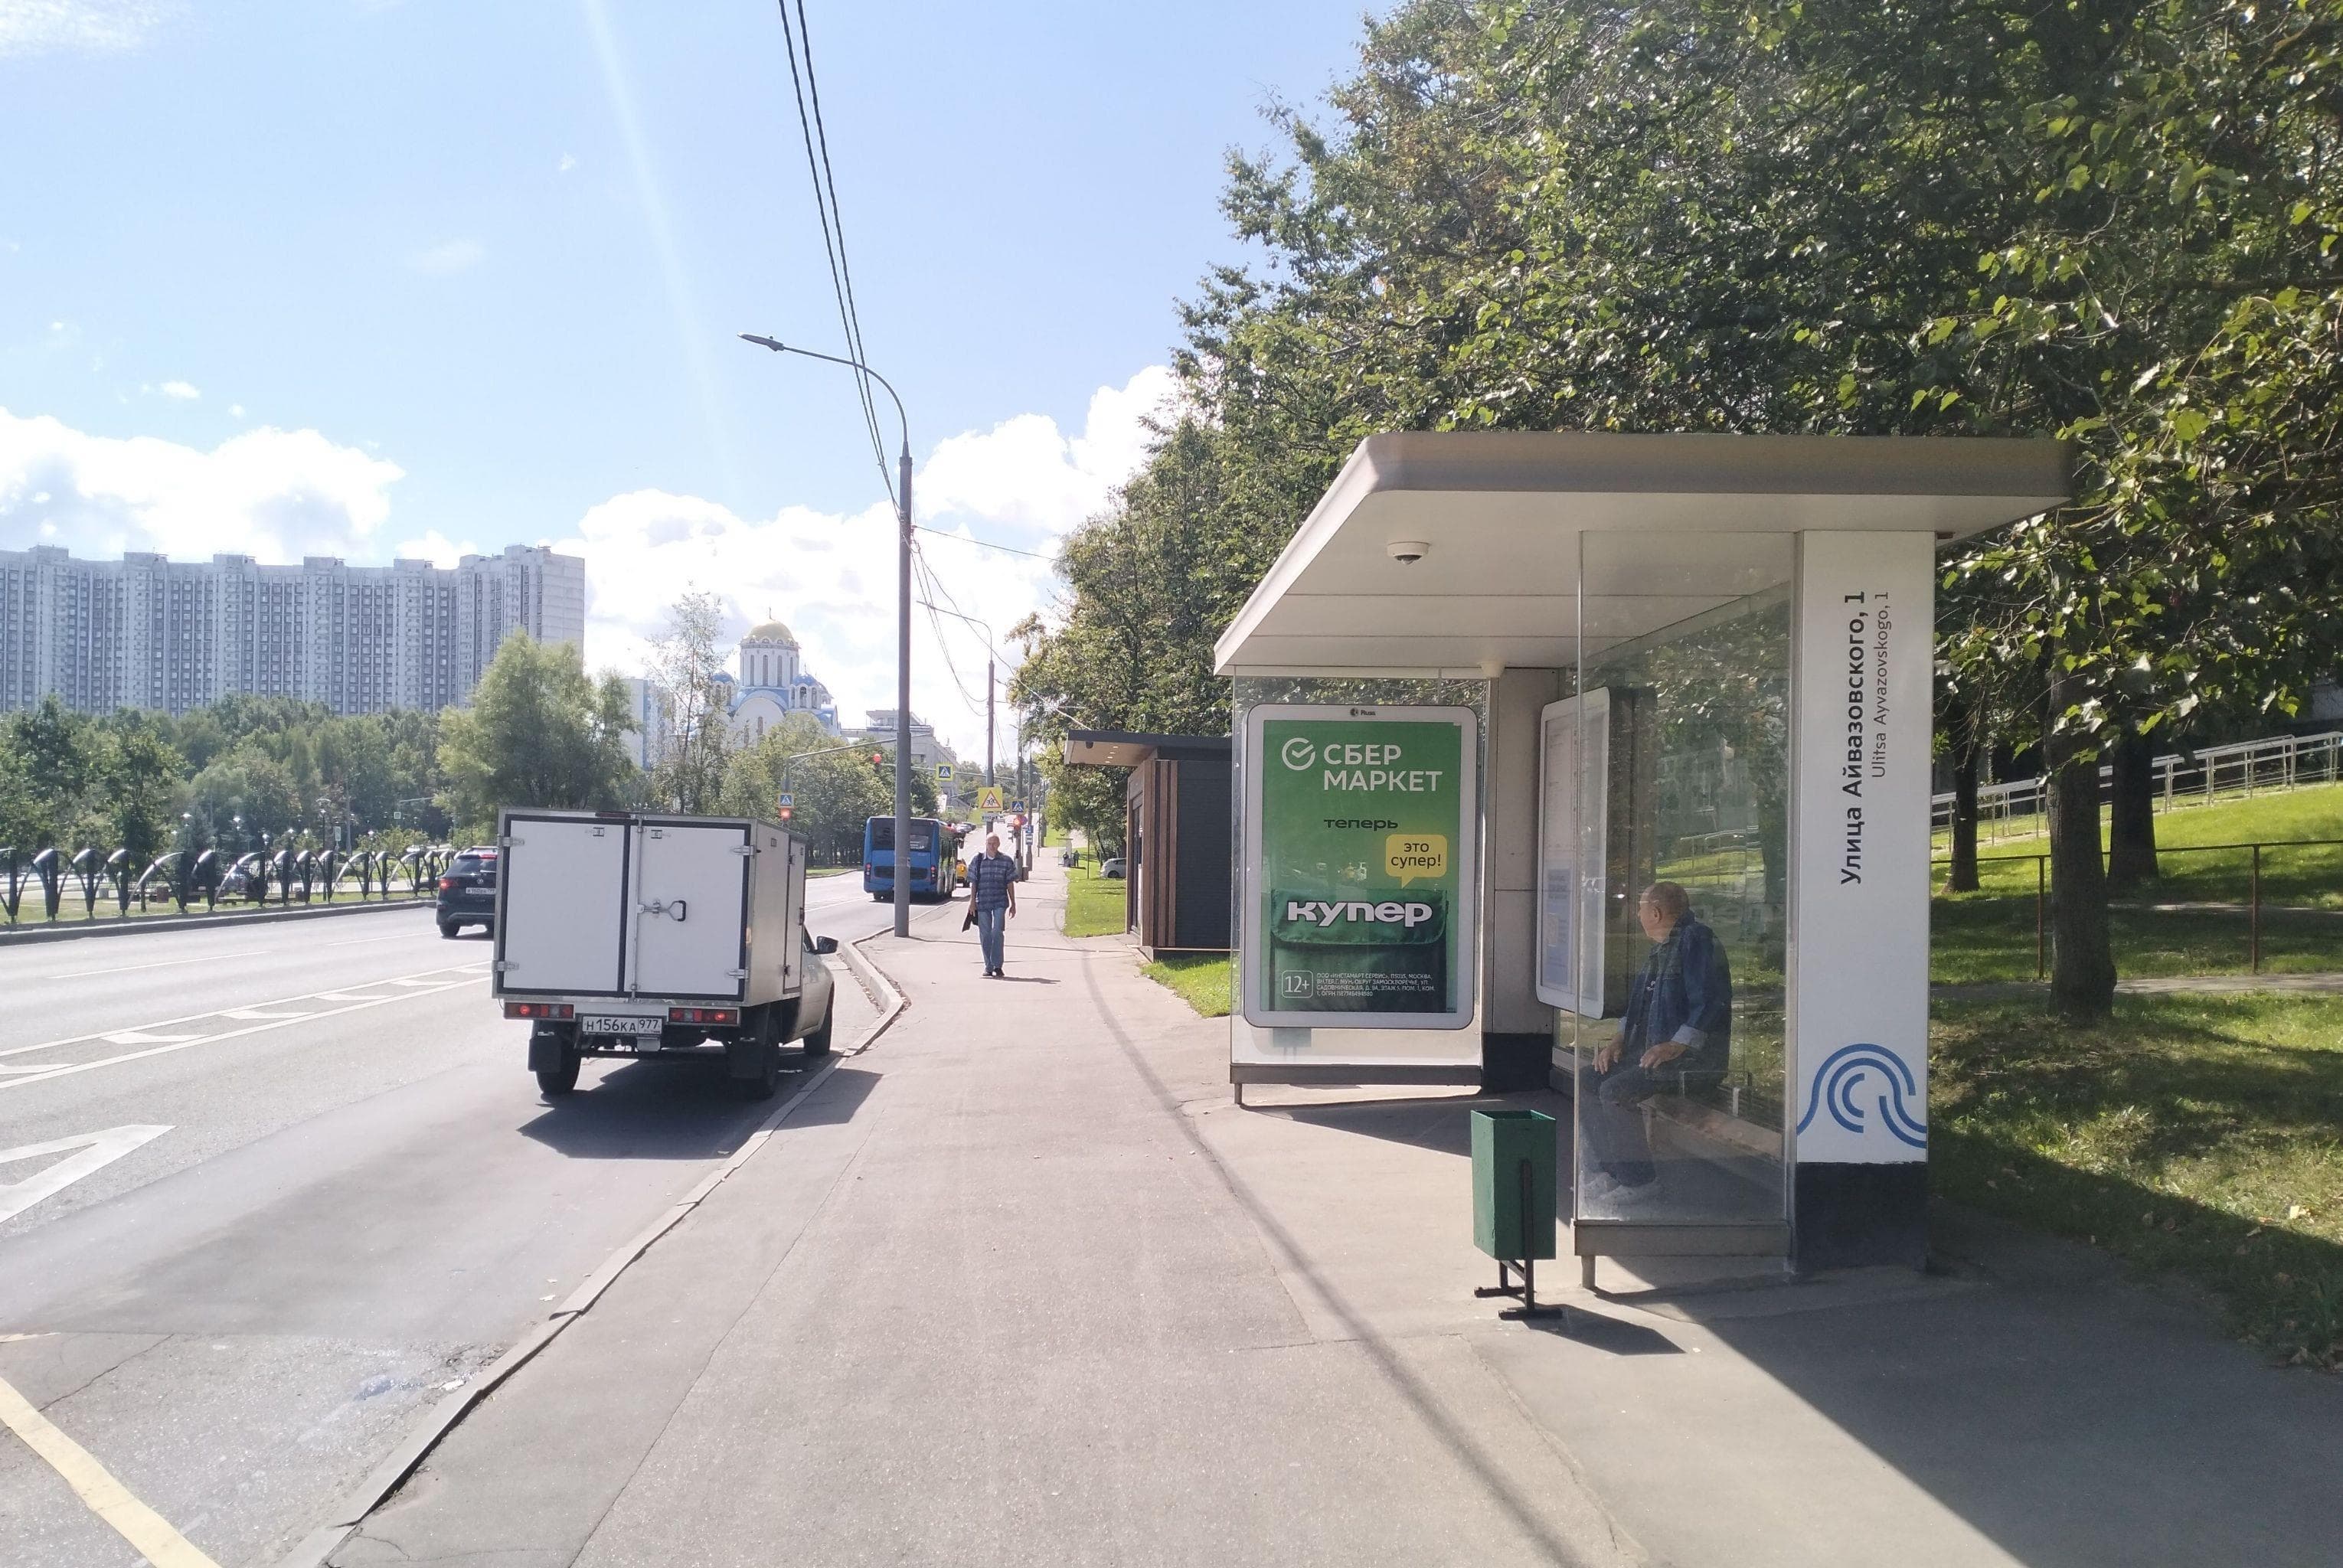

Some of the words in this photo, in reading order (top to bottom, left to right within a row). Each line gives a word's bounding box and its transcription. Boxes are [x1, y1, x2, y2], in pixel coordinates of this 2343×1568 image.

[1845, 590, 1864, 604] 1
[1875, 591, 1889, 600] 1
[1873, 605, 1892, 726] Ayvazovskogo,
[1841, 612, 1868, 799] Айвазовского,
[1323, 744, 1402, 766] СБЕР
[1871, 732, 1887, 779] Ulitsa
[1323, 769, 1443, 792] МАРКЕТ
[1323, 818, 1399, 831] теперь
[1404, 843, 1430, 853] это
[1841, 807, 1864, 885] Улица
[1390, 854, 1442, 870] супер!
[1286, 900, 1433, 928] купер
[1284, 975, 1310, 993] 12+
[639, 1019, 658, 1029] 977
